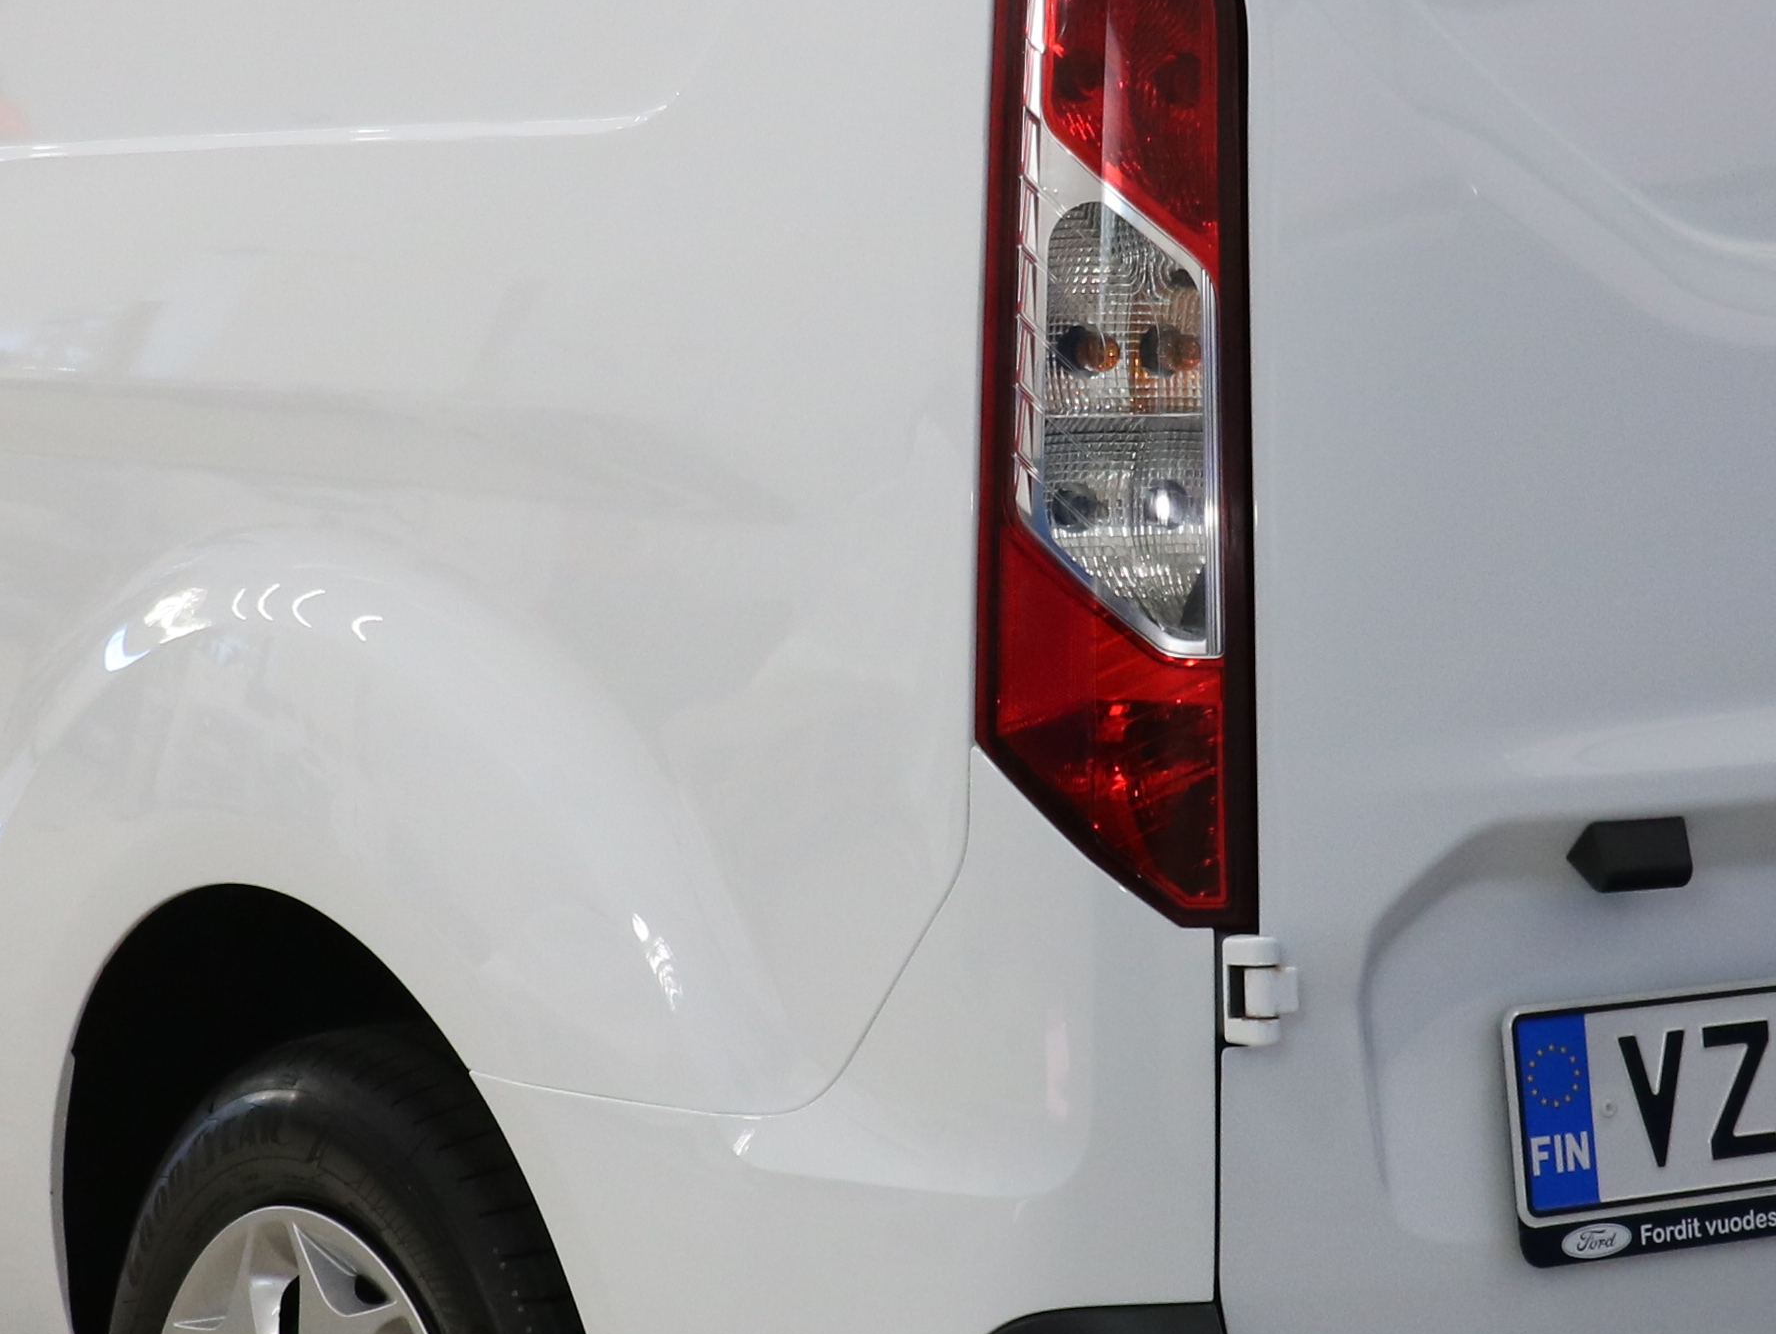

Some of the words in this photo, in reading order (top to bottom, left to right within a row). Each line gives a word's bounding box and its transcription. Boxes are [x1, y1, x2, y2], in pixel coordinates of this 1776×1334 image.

[1529, 1130, 1592, 1177] FIN
[1576, 1228, 1618, 1252] Ford
[1639, 1217, 1703, 1246] Fordit
